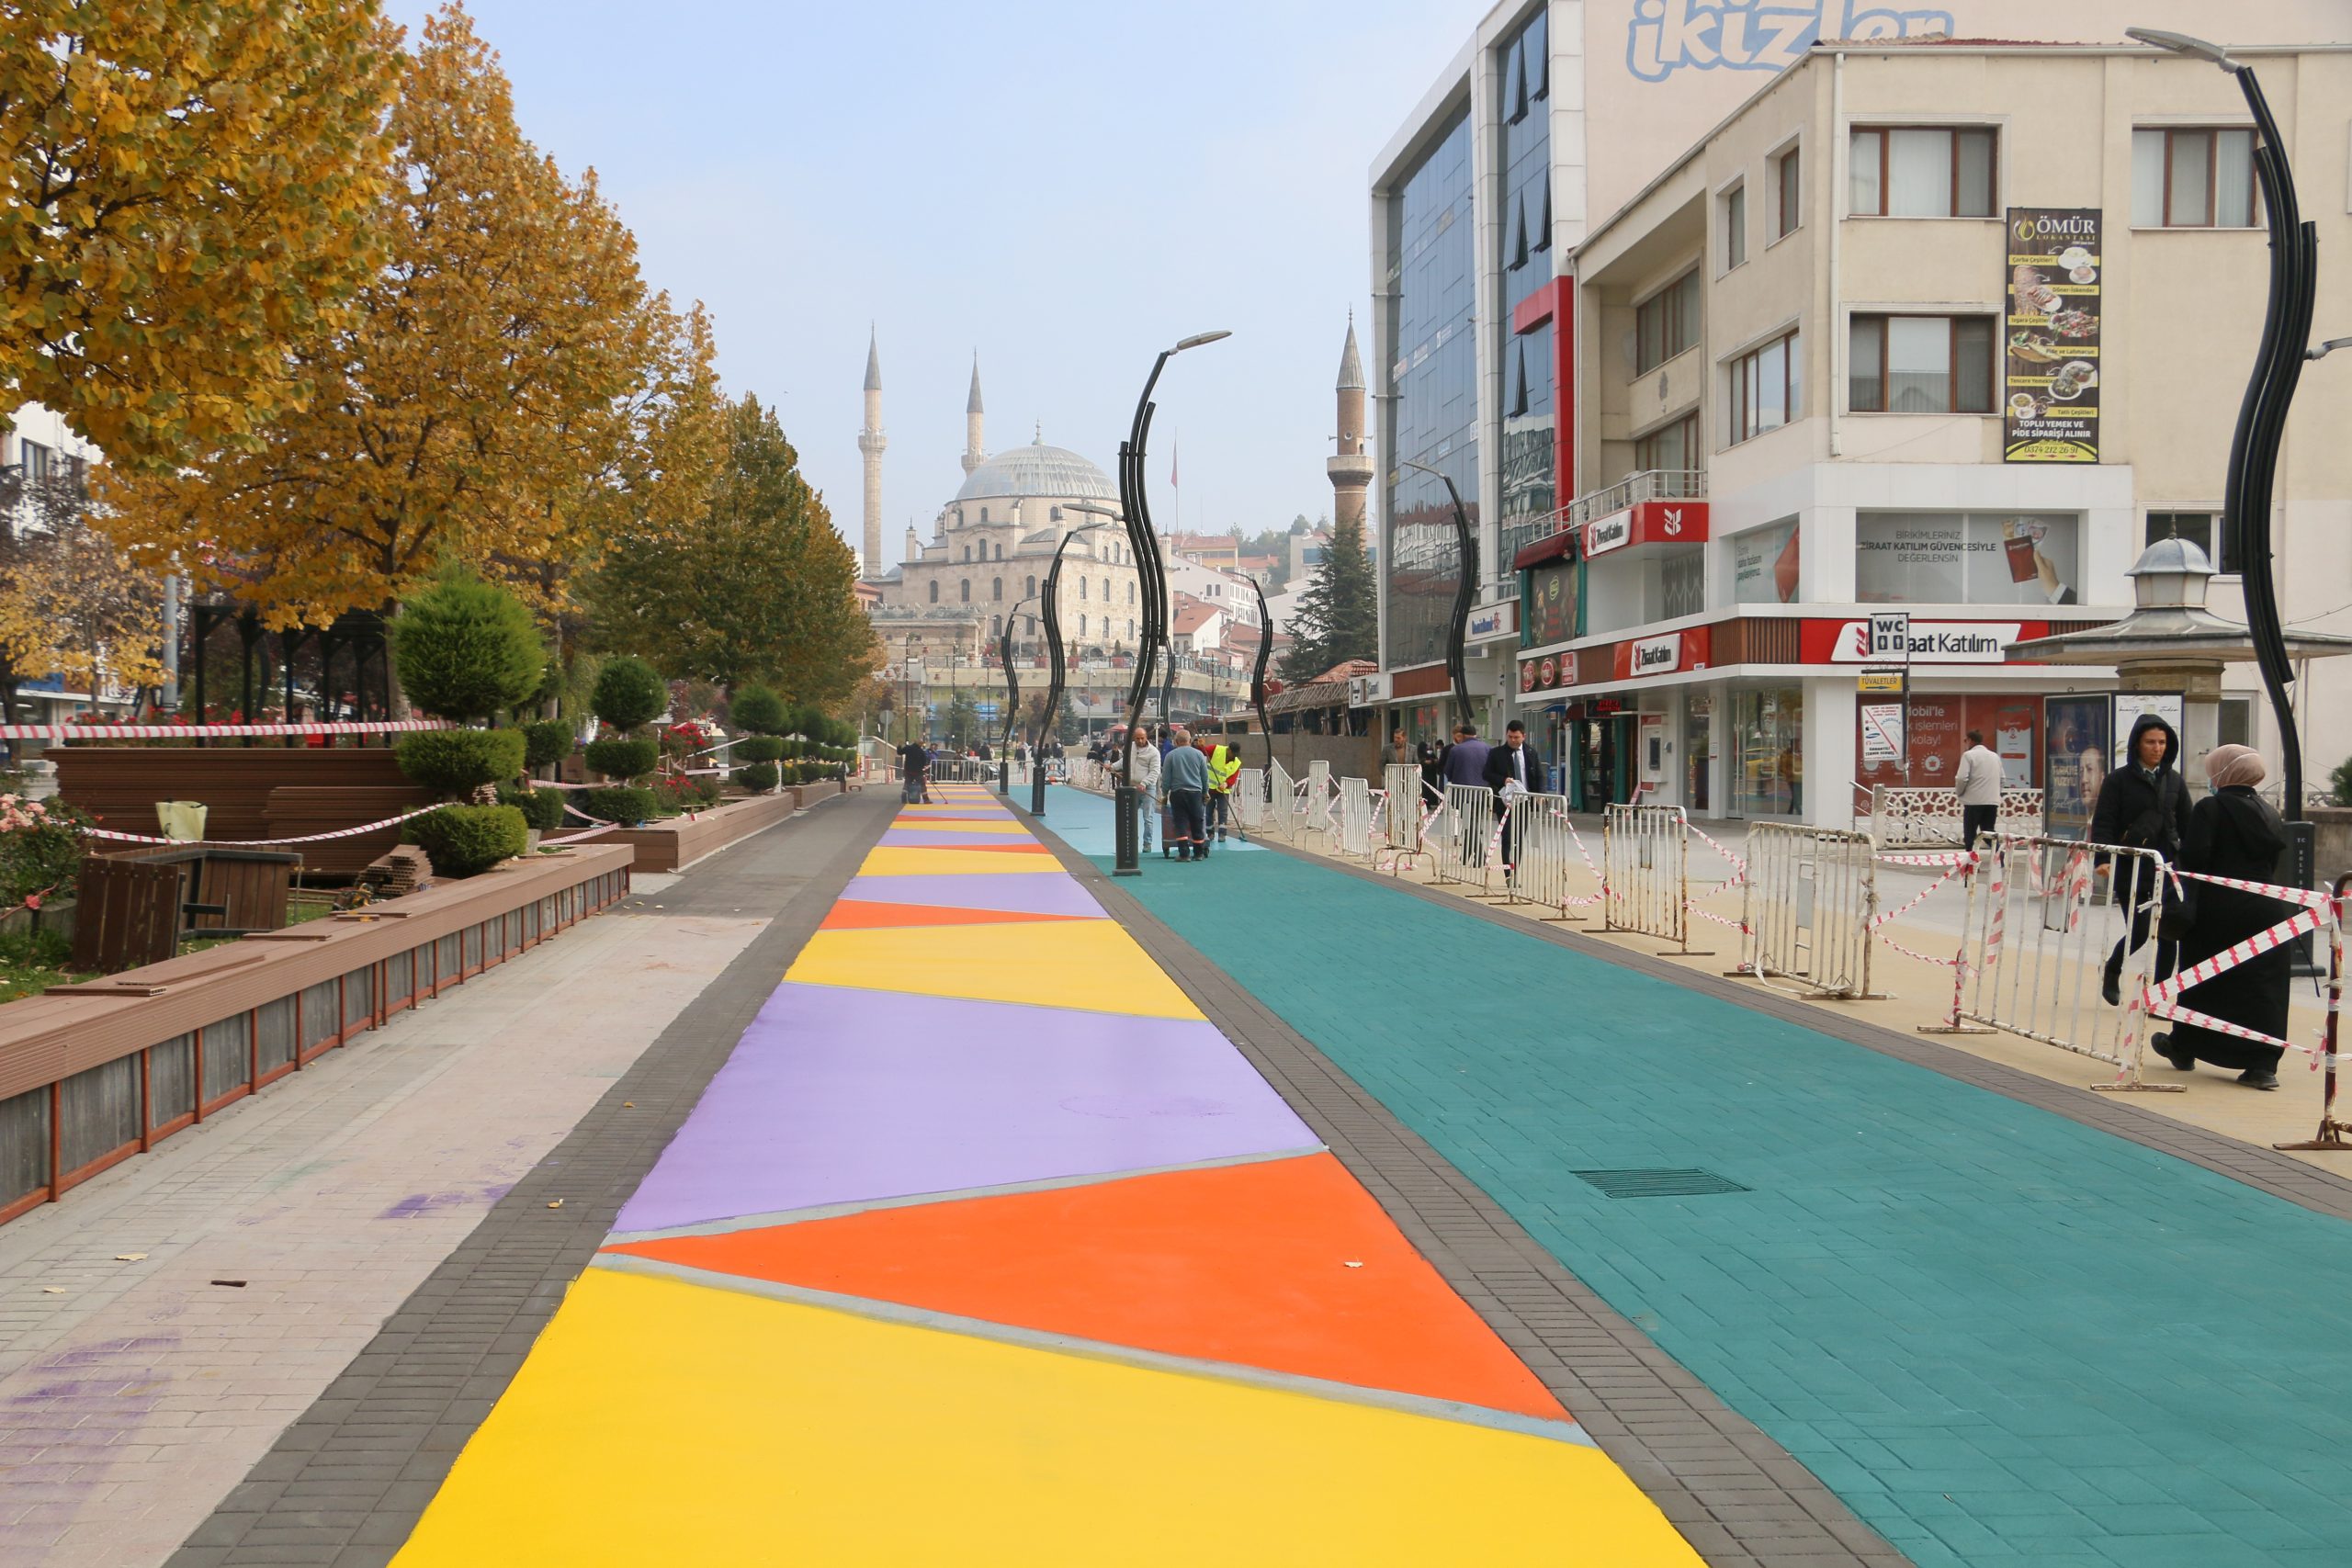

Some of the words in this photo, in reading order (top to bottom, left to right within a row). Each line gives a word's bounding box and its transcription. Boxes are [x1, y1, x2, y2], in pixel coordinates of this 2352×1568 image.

[2036, 216, 2095, 234] ÖMÜR
[2012, 428, 2030, 437] PİDE
[2031, 428, 2064, 439] SİPARİŞİ
[2044, 446, 2057, 454] 212
[1895, 530, 1961, 539] BİRİKİMLERİNİZ
[1860, 540, 1892, 551] ZİRAAT
[1894, 542, 1928, 551] KATILIM
[1929, 541, 1996, 551] GÜVENCESİYLE
[1897, 553, 1959, 562] DEĞERLENSİN
[1876, 620, 1904, 632] WC
[1939, 633, 1997, 653] Katılım
[1916, 720, 1959, 731] işlemleri
[1911, 734, 1941, 746] kolay!
